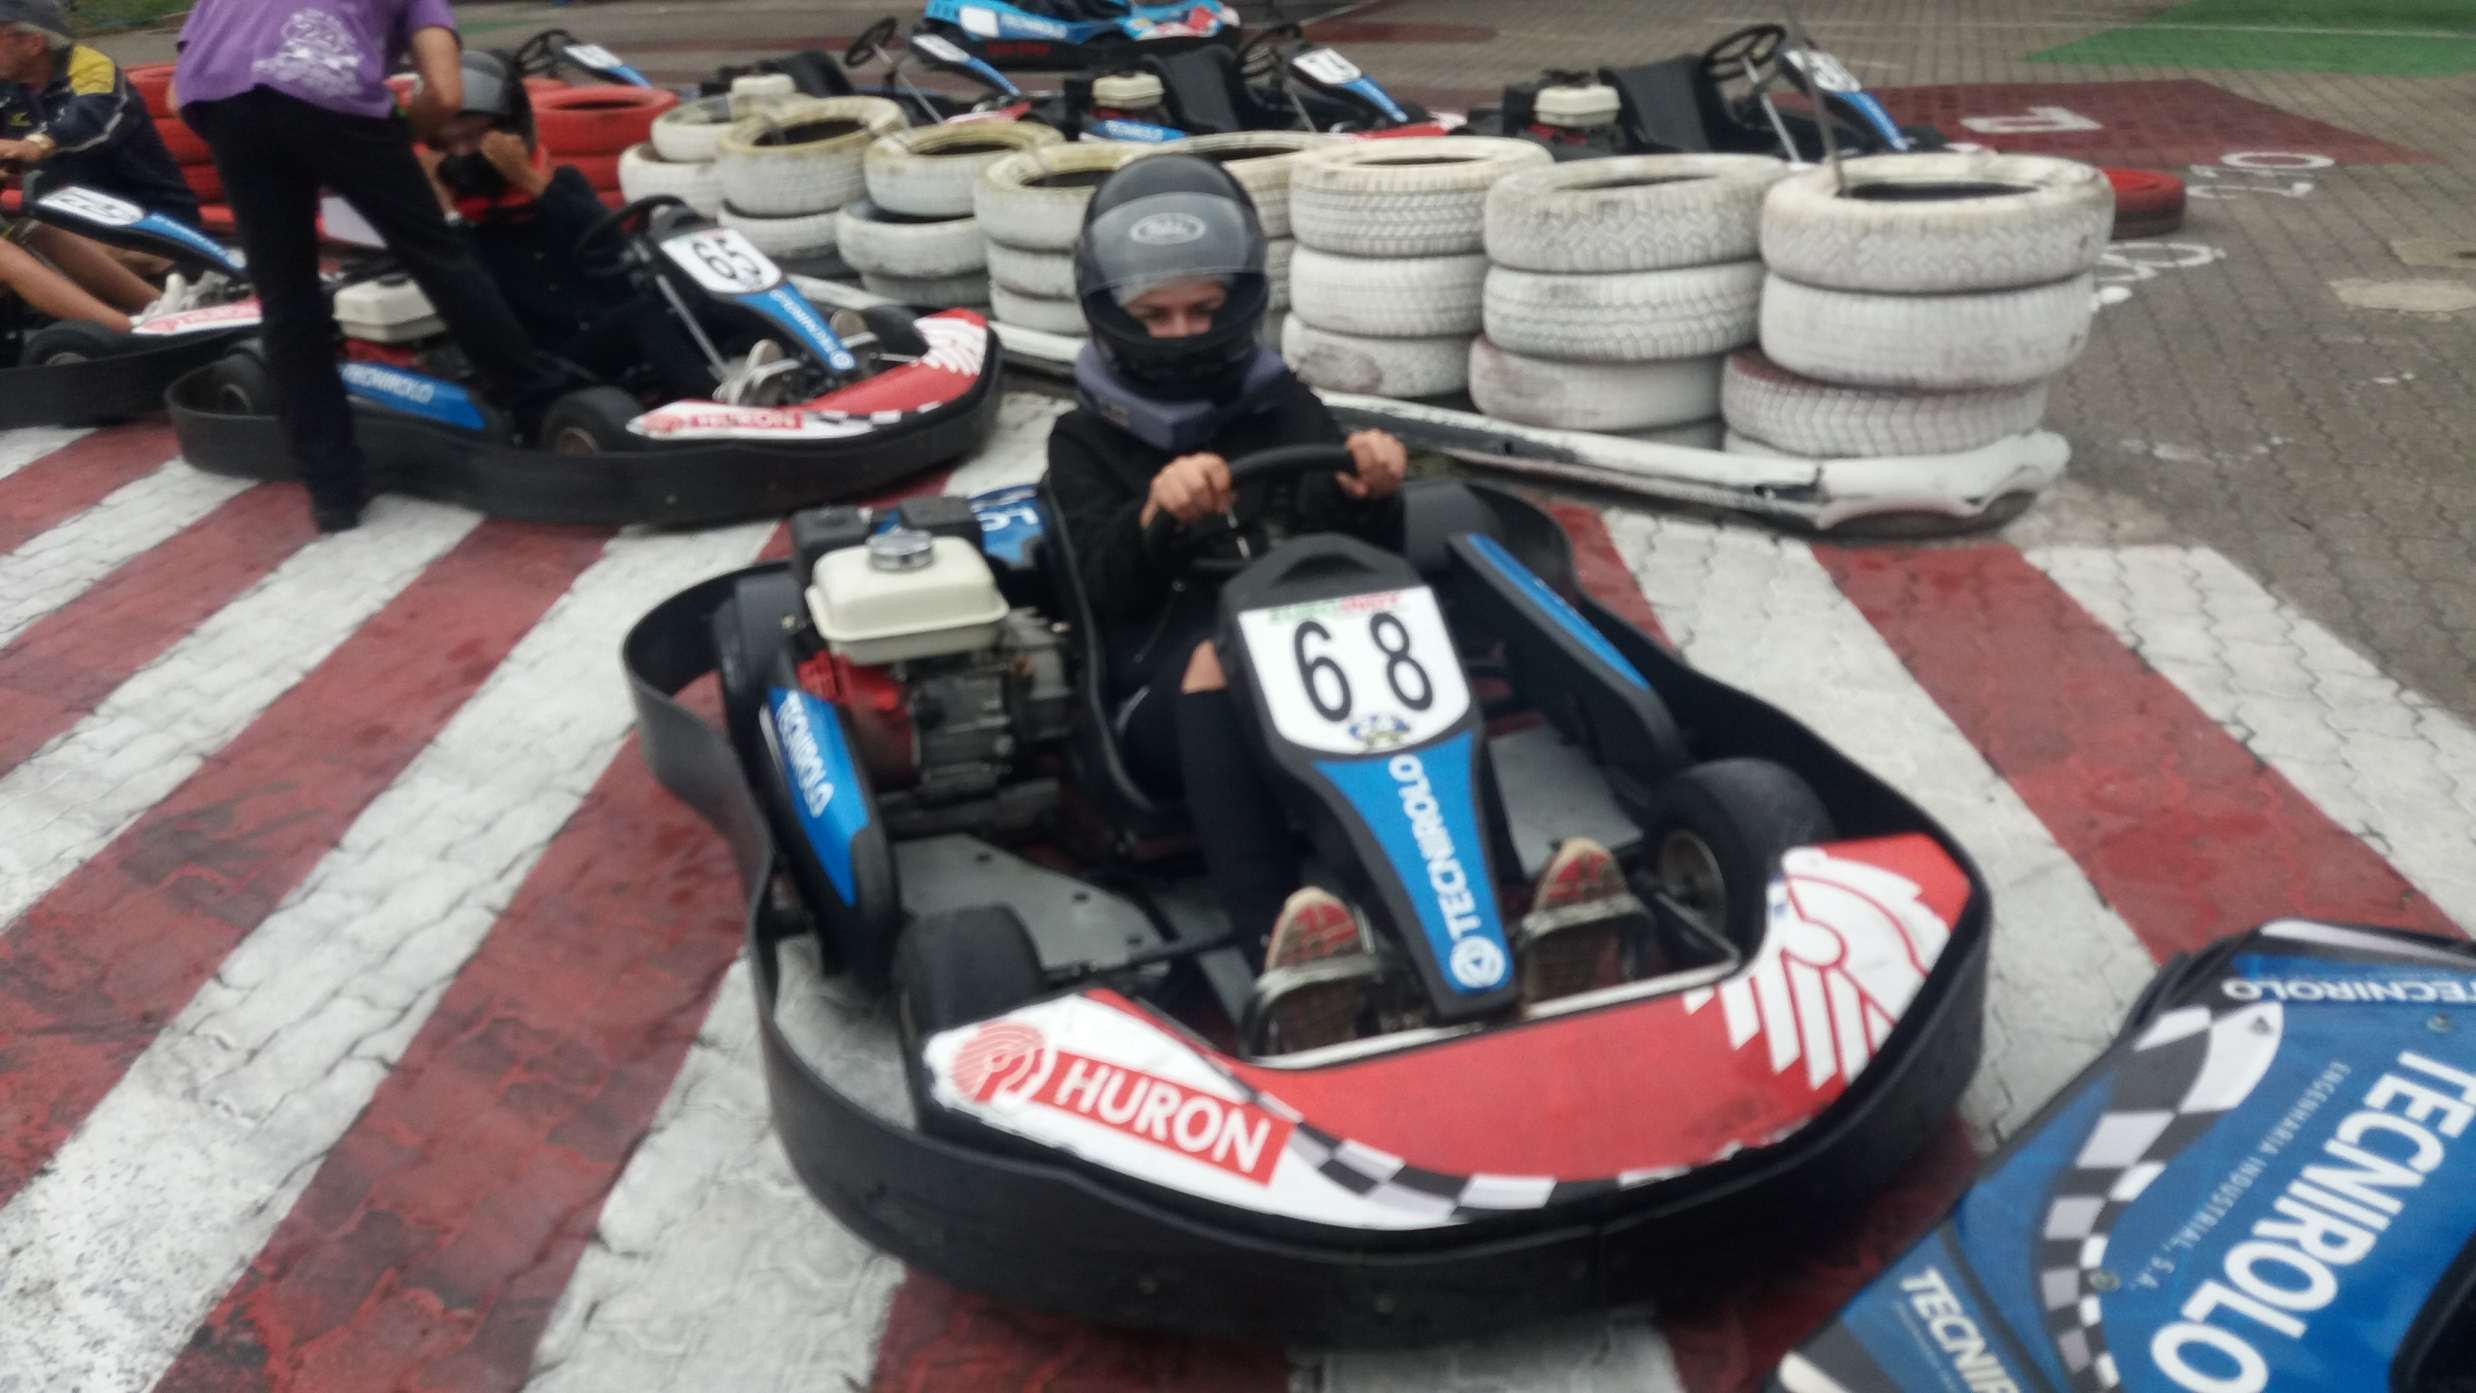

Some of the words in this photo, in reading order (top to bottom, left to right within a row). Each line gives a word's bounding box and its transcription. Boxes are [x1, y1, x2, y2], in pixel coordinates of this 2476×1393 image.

[692, 236, 761, 279] 65
[1295, 612, 1433, 722] 68
[1389, 755, 1482, 941] TECNIROLO
[1055, 1058, 1271, 1174] HURON
[2258, 1060, 2351, 1156] ENGENHARIA
[2150, 1050, 2476, 1393] TECNIROLO
[2164, 1155, 2267, 1252] INDUSTRIAL,
